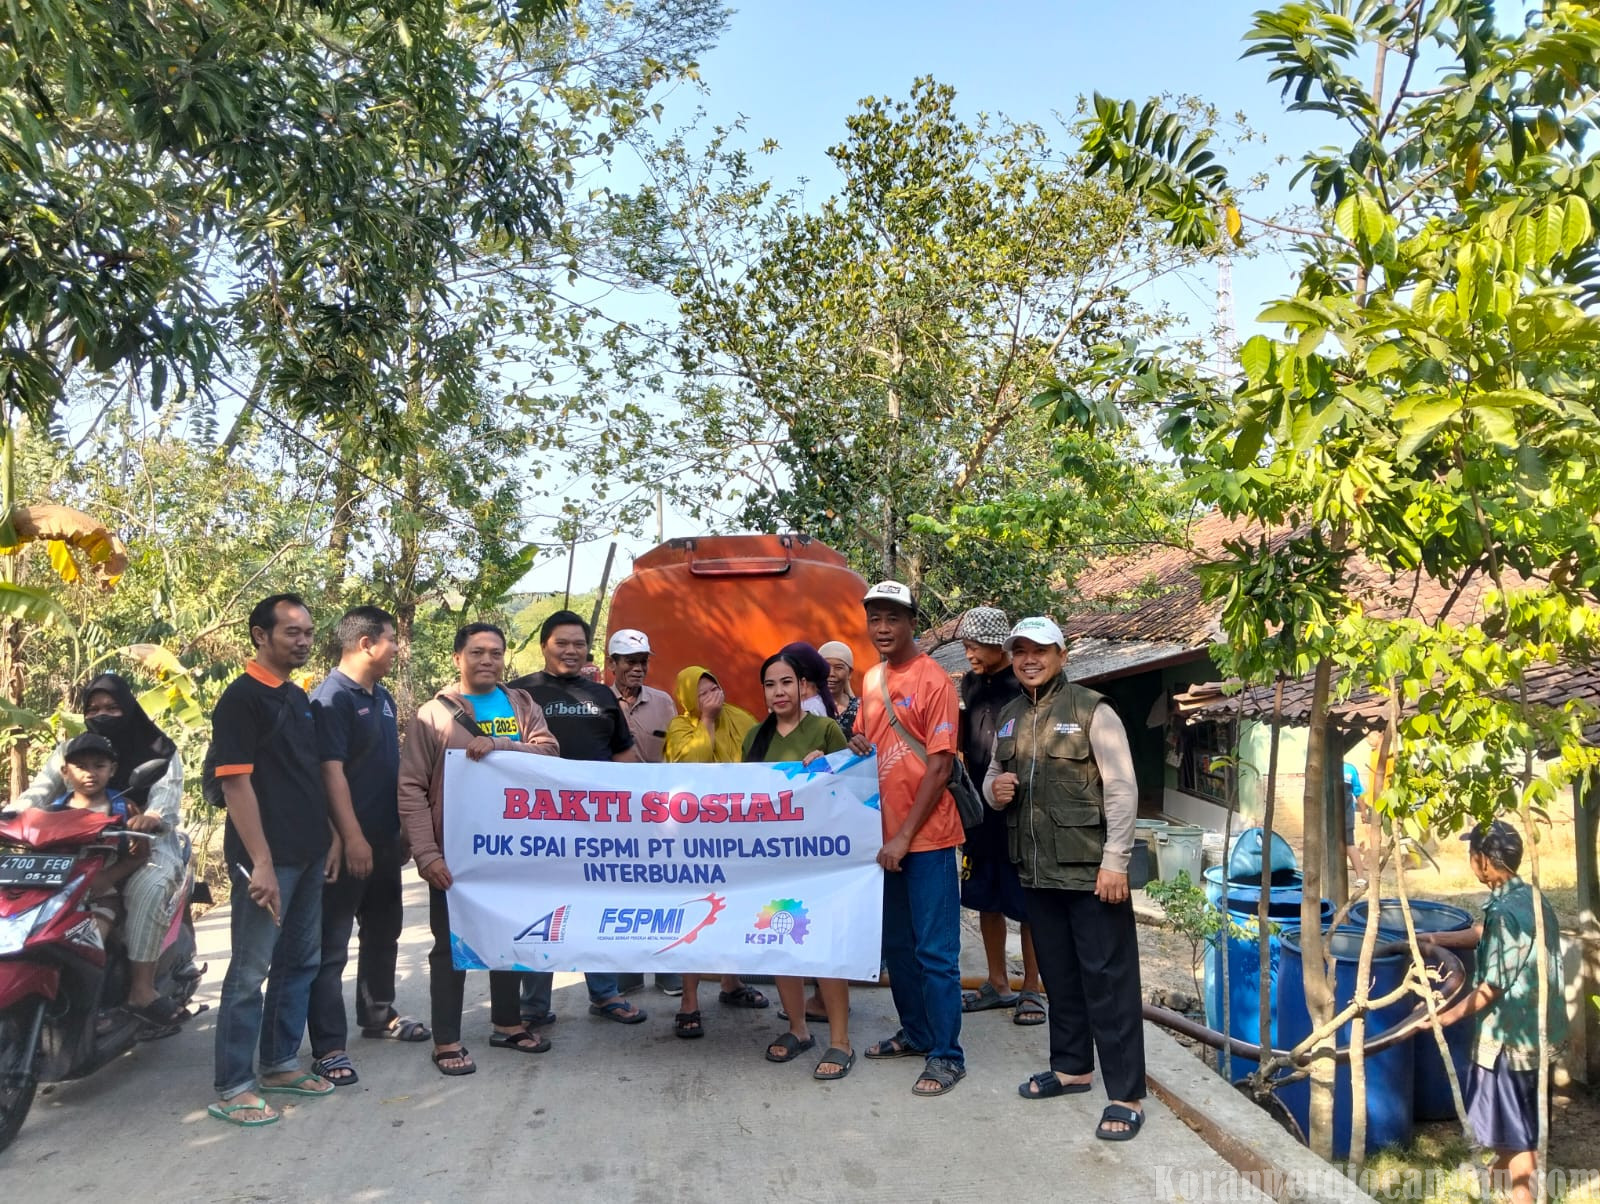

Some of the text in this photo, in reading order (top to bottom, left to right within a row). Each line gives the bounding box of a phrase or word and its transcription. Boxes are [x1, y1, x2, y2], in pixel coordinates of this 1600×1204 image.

[495, 719, 518, 733] 2025
[503, 788, 804, 823] BAKTI SOSIAL
[473, 834, 851, 858] PUK SPAI FSPMI PT UNIPLASTINDO
[583, 863, 726, 884] INTERBUANA
[599, 908, 685, 933] FSPMI
[745, 933, 784, 944] KSPI
